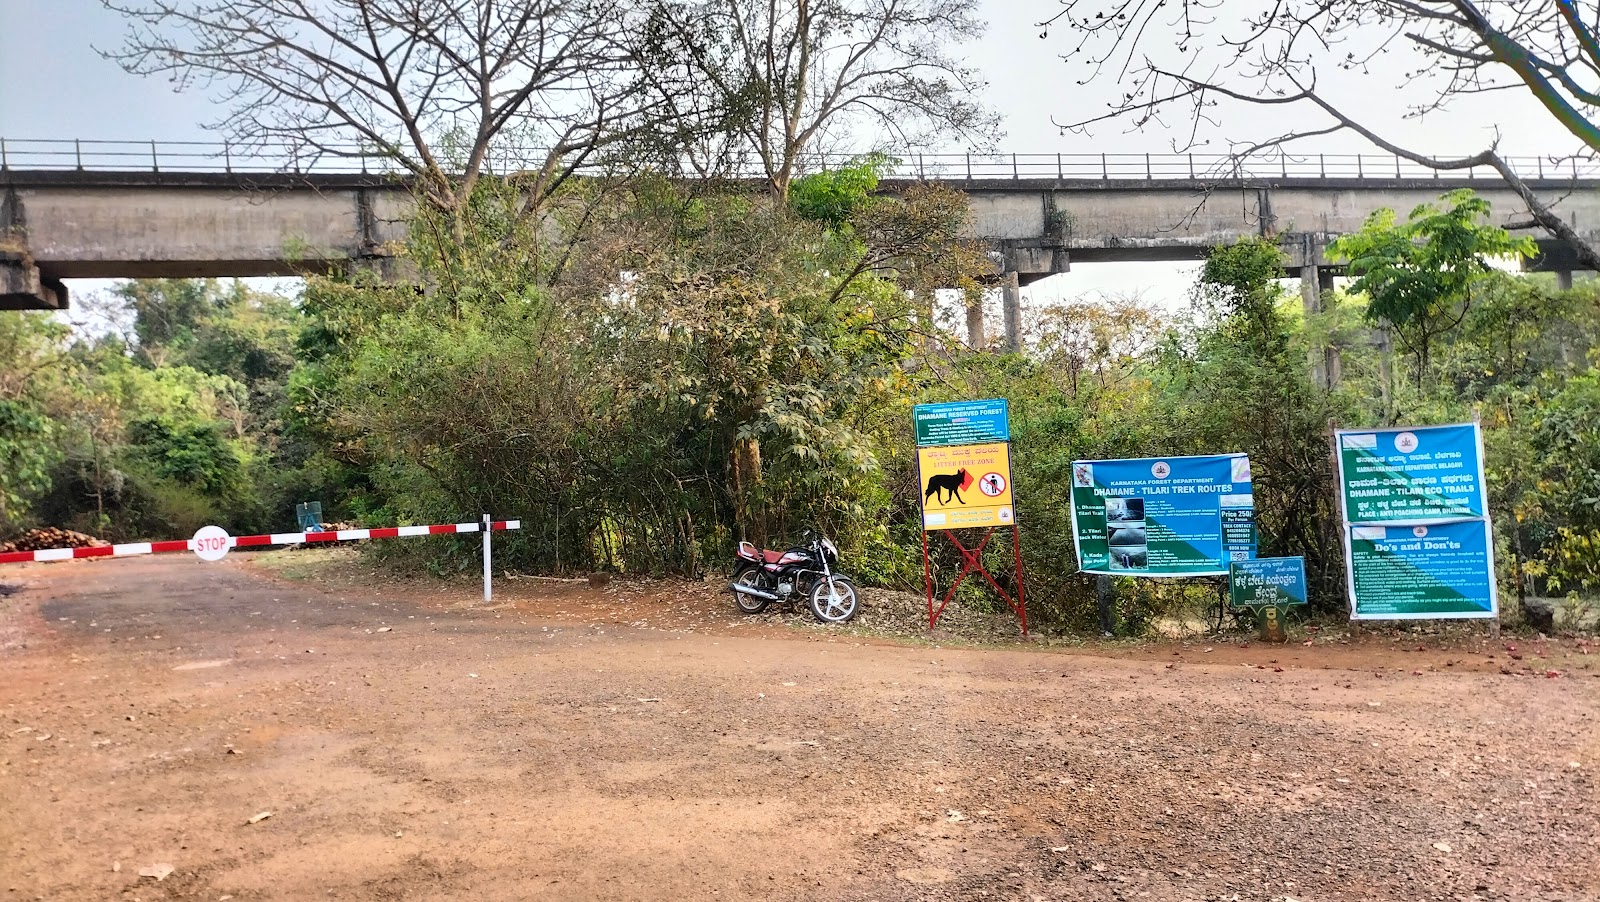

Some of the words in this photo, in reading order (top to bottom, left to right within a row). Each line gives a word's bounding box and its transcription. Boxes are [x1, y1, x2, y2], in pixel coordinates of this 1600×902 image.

[1094, 488, 1135, 496] DHAMANE
[1142, 486, 1169, 495] TILARI
[1198, 484, 1232, 493] ROUTES
[1350, 488, 1390, 497] DHAMANE
[1444, 485, 1474, 493] TRAILS
[198, 537, 226, 551] STOP
[1401, 542, 1421, 550] and
[1424, 541, 1460, 549] Don'ts
[1266, 574, 1296, 586] ನಿಯಂತ್ರಣ
